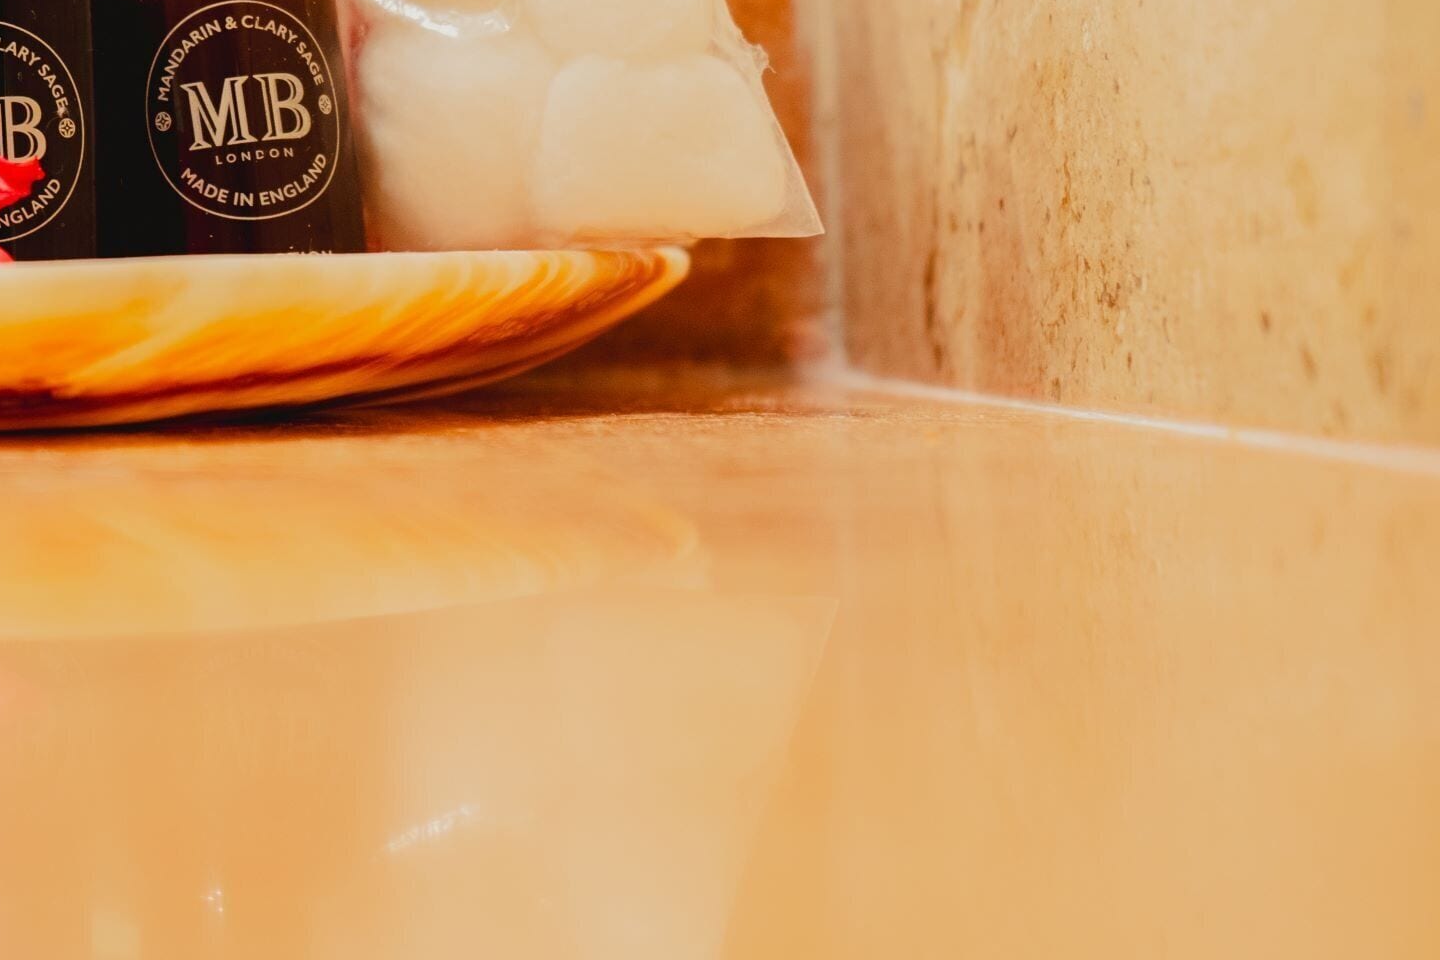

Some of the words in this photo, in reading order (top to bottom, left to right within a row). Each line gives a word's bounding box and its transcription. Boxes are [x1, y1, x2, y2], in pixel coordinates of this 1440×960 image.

[158, 19, 221, 101] MANDARIN
[225, 16, 238, 30] &
[241, 15, 297, 43] CLARY
[296, 41, 324, 86] SAGE
[38, 63, 68, 111] SAGE
[180, 72, 312, 151] MB
[180, 168, 229, 204] MADE
[233, 192, 254, 207] IN
[260, 153, 327, 206] ENGLAND
[216, 147, 295, 165] LONDON
